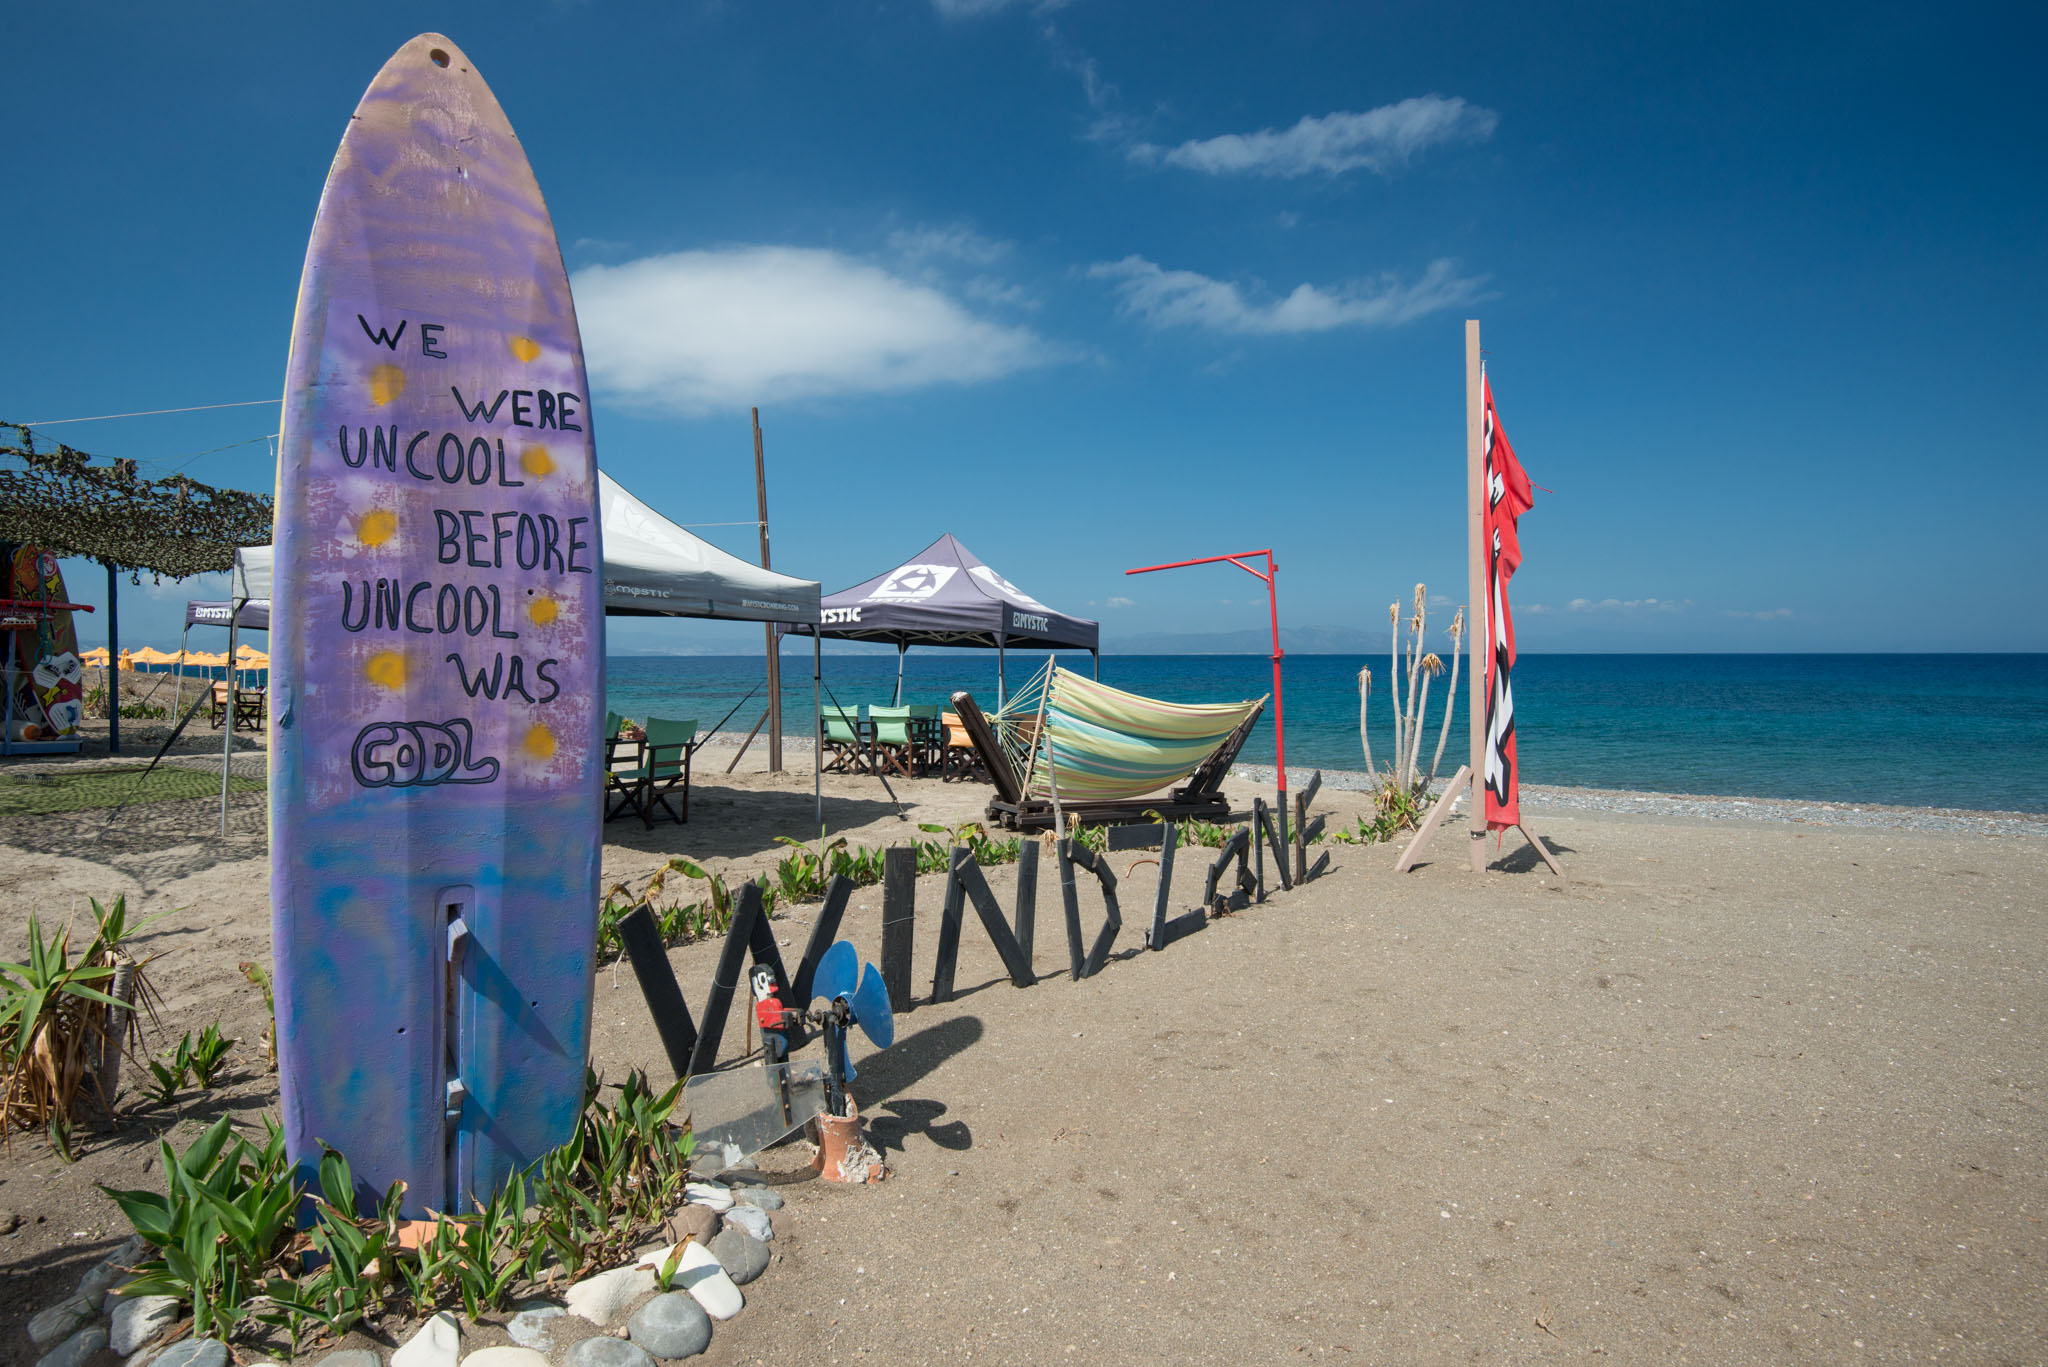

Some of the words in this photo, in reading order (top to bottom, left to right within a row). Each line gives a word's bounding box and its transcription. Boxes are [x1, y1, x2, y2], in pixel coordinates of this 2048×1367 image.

[357, 314, 447, 359] WE
[452, 386, 582, 431] WERE
[339, 425, 524, 486] UNCOOL
[433, 510, 592, 574] BEFORE
[342, 578, 519, 639] UNCOOL
[820, 607, 861, 623] YSTIC
[1020, 613, 1048, 632] MYSTIC
[446, 652, 560, 703] WAS
[351, 718, 499, 788] COOL
